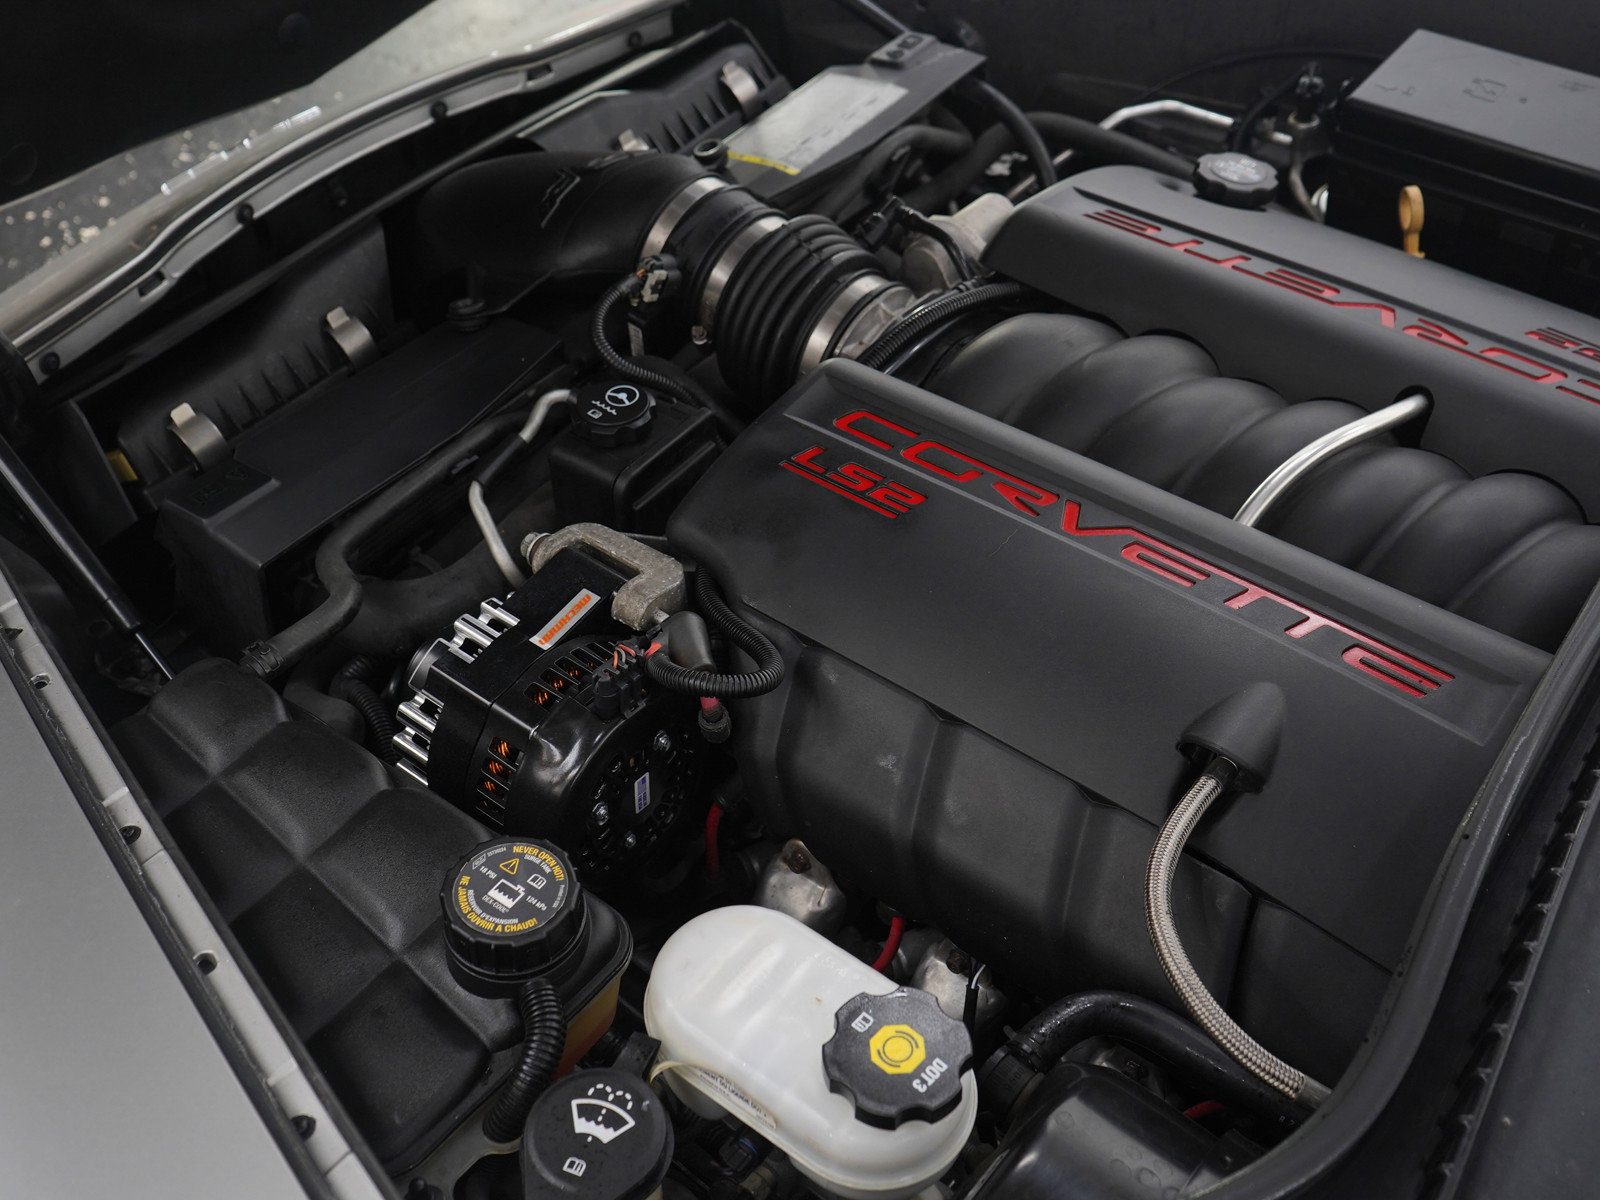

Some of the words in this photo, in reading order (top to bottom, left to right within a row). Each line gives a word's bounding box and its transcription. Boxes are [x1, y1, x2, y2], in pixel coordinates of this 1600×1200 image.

[788, 445, 928, 515] LS2
[834, 410, 1455, 698] CORVETTE
[538, 594, 592, 645] MECHMAN
[513, 845, 538, 857] NEVER
[538, 851, 557, 867] OPEN
[551, 864, 565, 882] HOT!
[524, 854, 542, 865] SURGE
[540, 861, 552, 874] TANK
[459, 875, 471, 886] NE
[485, 870, 498, 880] PSI
[457, 886, 472, 914] JAMAIS
[526, 895, 537, 905] 124
[466, 912, 493, 931] OUVRIR
[504, 918, 538, 933] CHAUD!
[925, 1057, 949, 1087] DOT
[912, 1077, 928, 1093] 3
